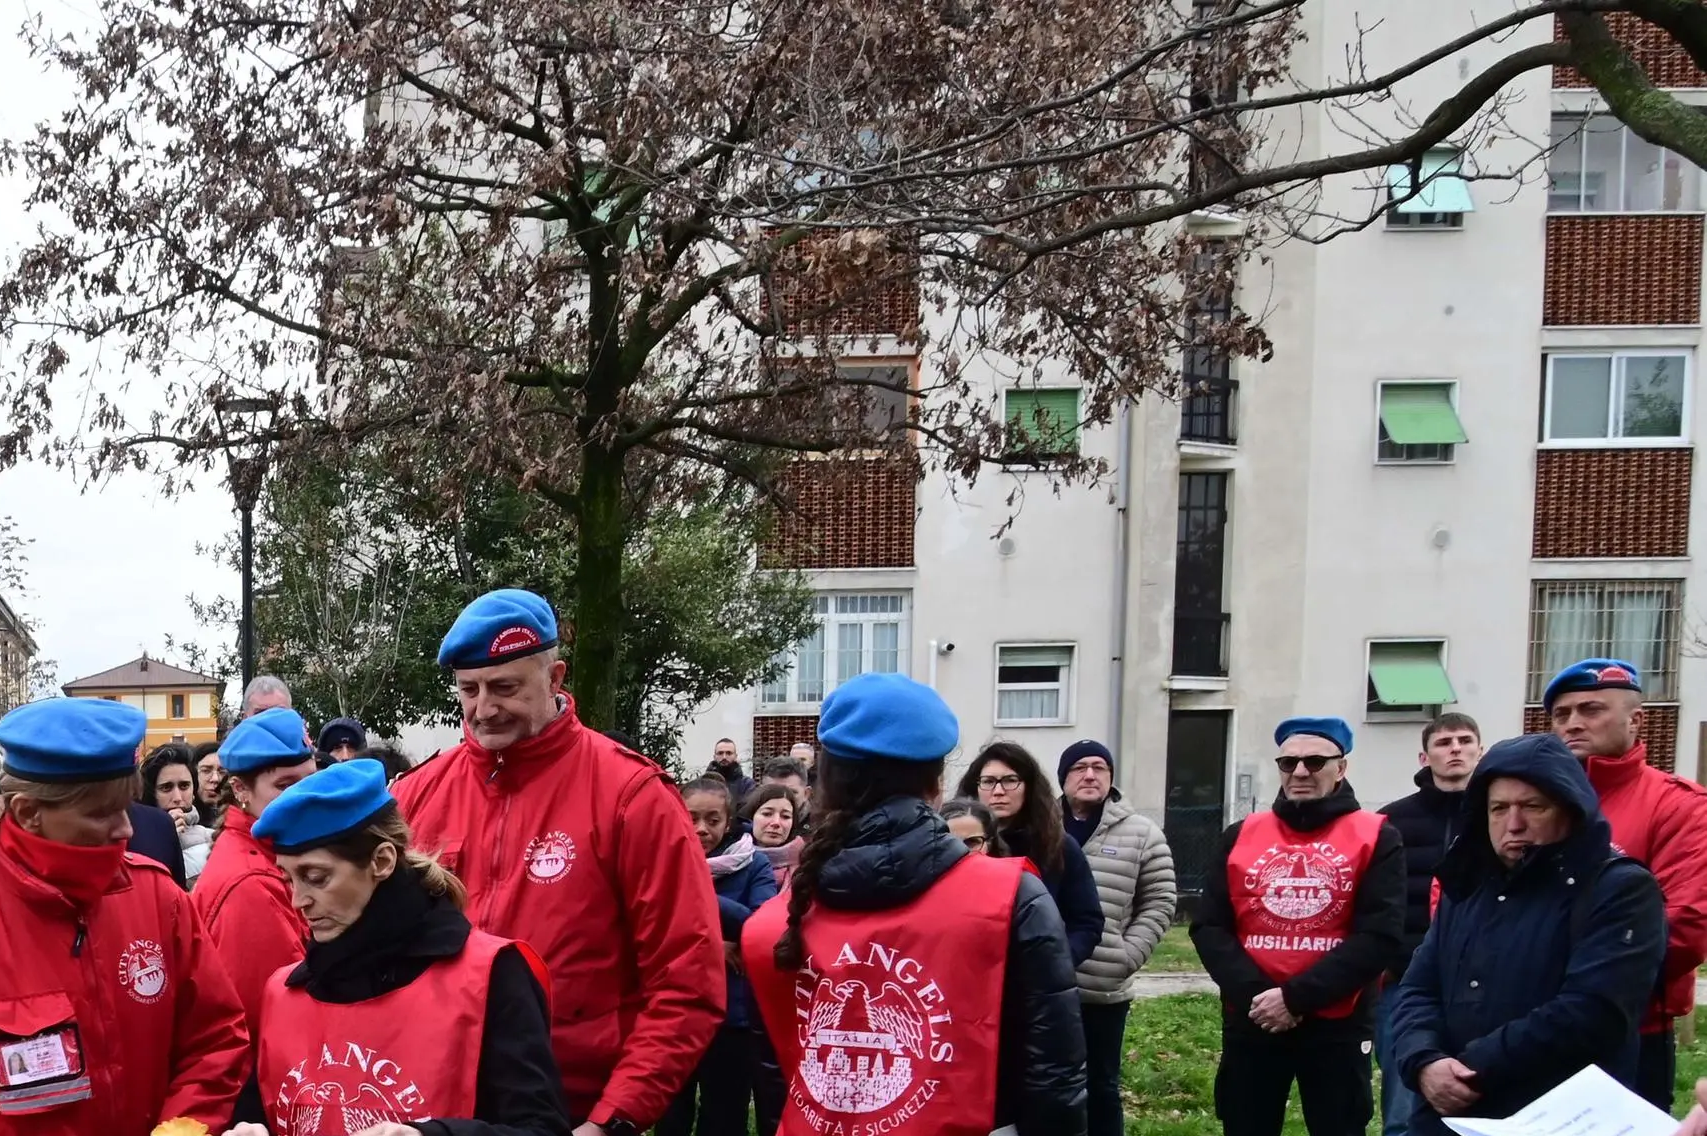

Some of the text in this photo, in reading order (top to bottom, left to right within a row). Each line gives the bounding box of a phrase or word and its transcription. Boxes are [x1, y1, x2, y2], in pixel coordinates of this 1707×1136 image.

[544, 830, 577, 860] ANGELS
[1244, 842, 1353, 892] CITY GELS
[118, 939, 163, 986] CITY ANGE
[795, 942, 954, 1063] CITY ANGELS
[828, 1034, 882, 1045] ITALIA
[317, 1041, 432, 1123] ANGE
[789, 1074, 844, 1136] LIDARIETÀ
